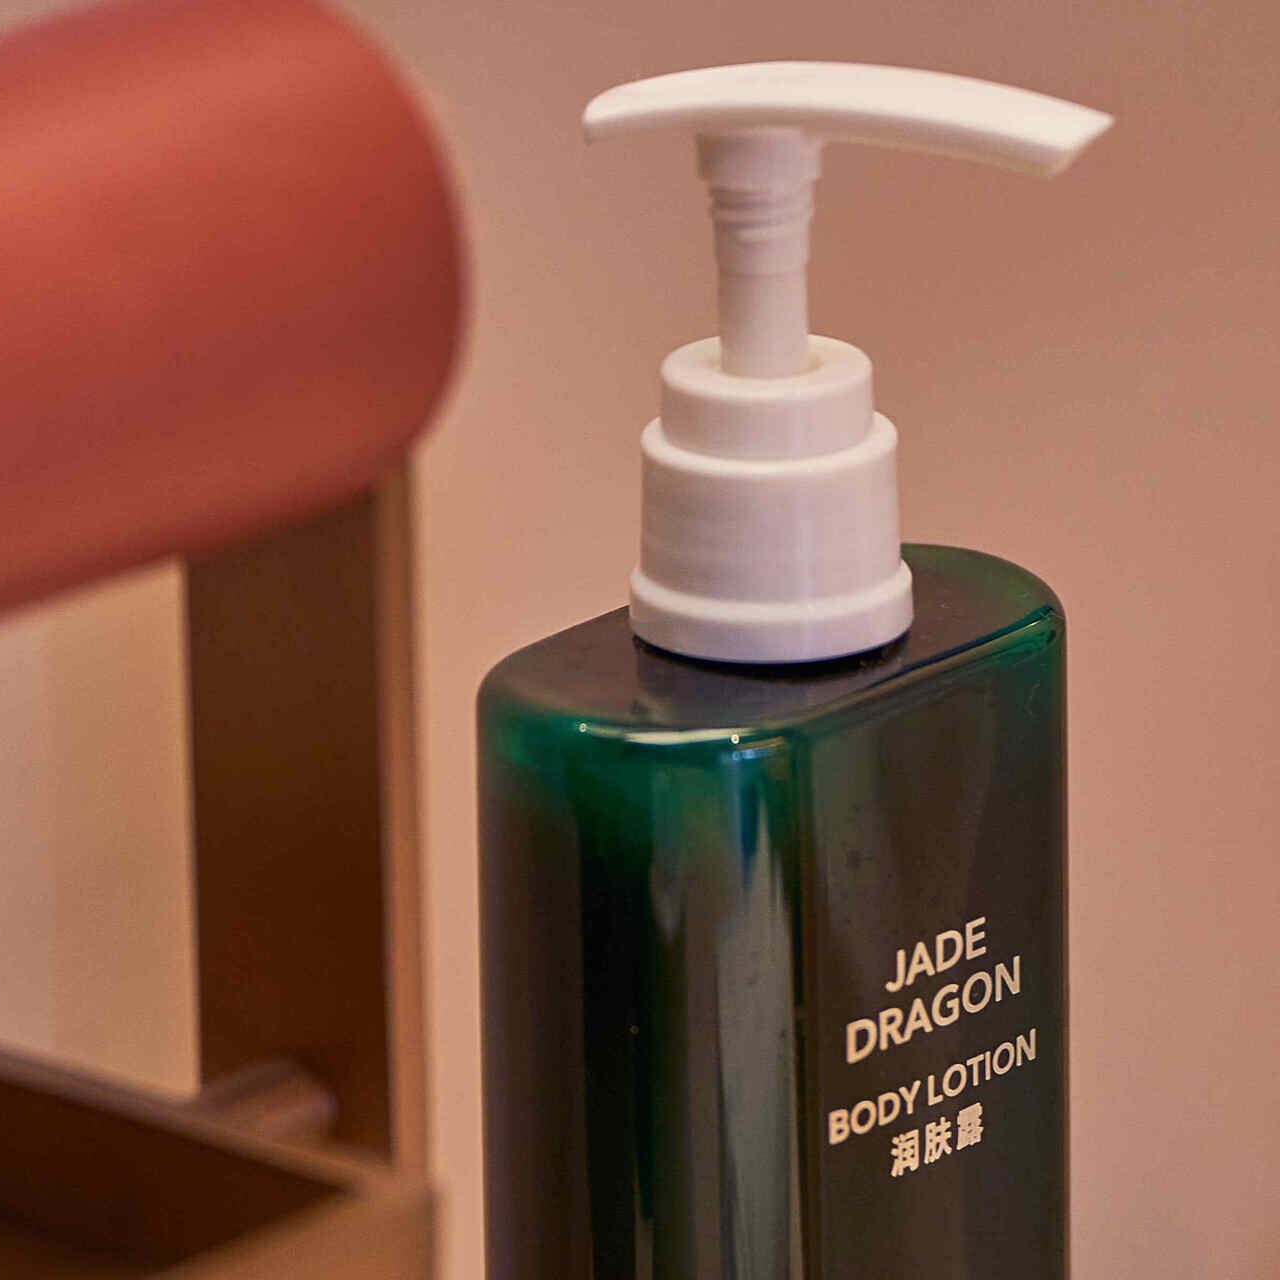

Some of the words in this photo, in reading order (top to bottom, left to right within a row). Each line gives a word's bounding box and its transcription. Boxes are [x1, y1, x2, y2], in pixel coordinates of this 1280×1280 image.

[885, 916, 987, 992] JADE
[846, 955, 1021, 1064] DRAGON
[828, 1080, 921, 1145] BODY
[927, 1028, 1037, 1106] LOTION
[890, 1102, 984, 1177] 润肤露
